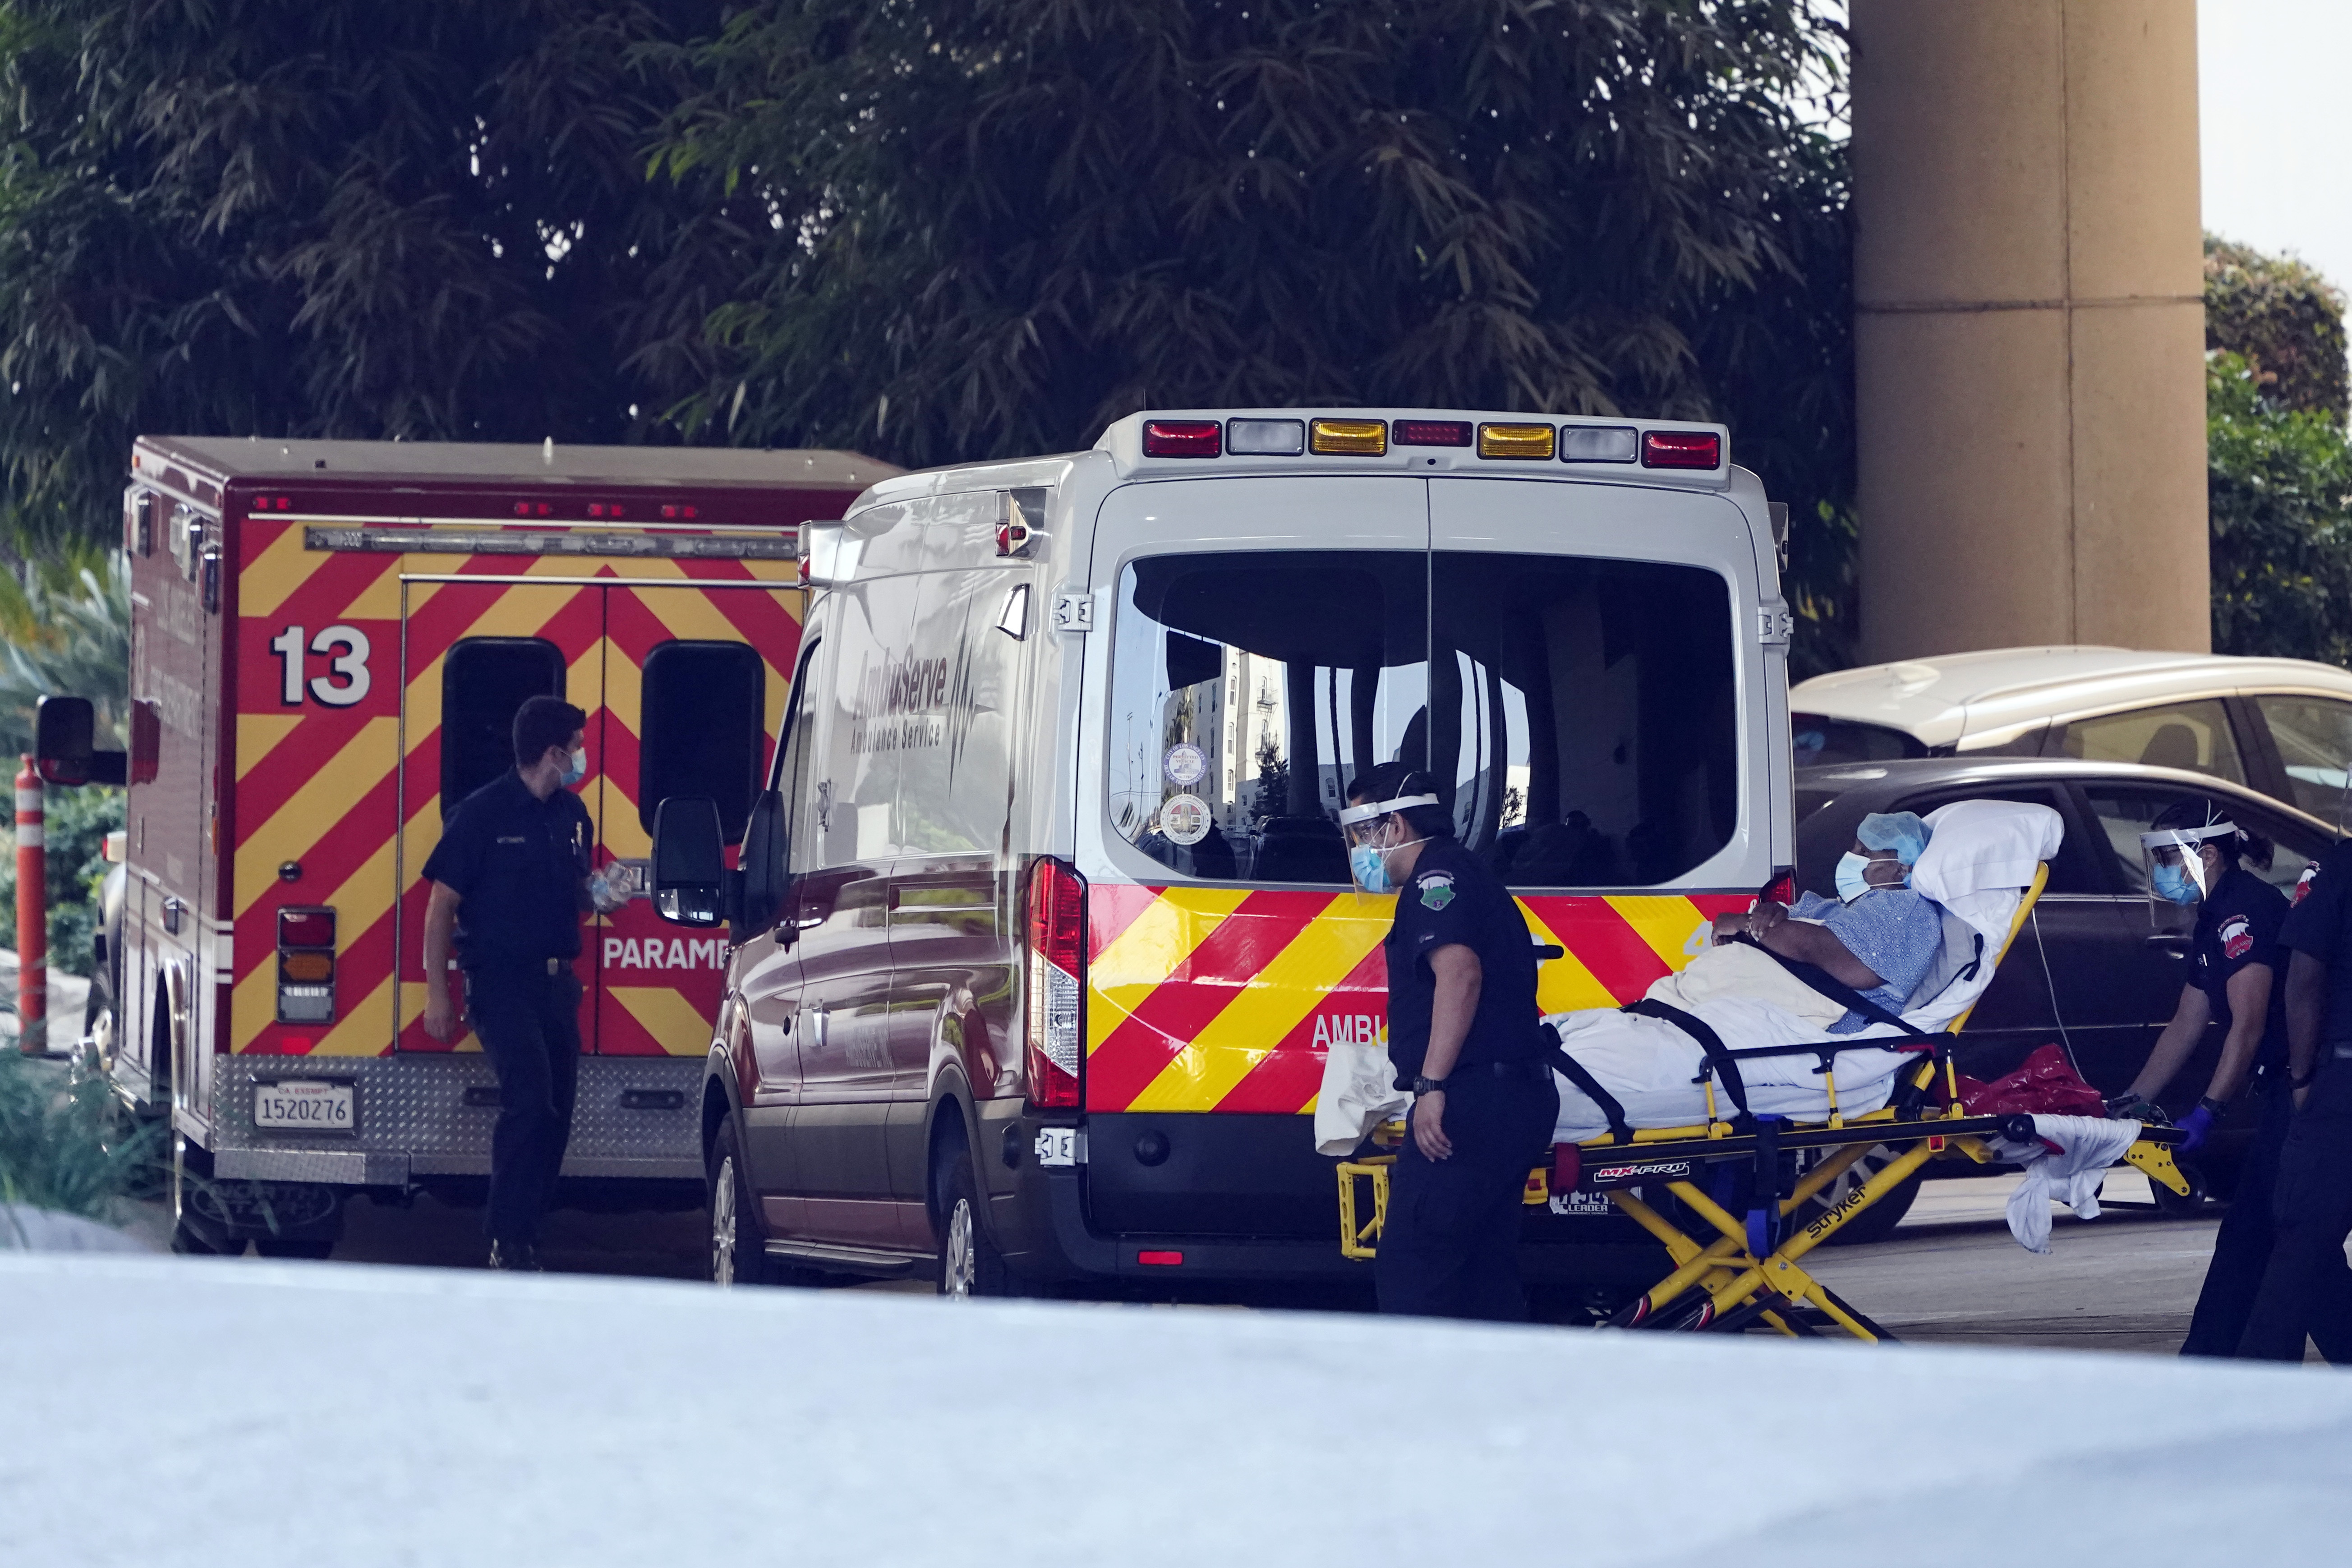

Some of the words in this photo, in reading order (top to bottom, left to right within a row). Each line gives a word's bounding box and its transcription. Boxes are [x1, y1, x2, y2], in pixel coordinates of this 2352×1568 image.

[270, 624, 370, 709] 13
[852, 642, 947, 721] AmbuServe
[850, 722, 898, 755] Ambulance
[902, 719, 940, 749] Service
[1165, 750, 1174, 759] CITY
[1190, 744, 1206, 760] ANGELES
[1164, 797, 1178, 809] COUNTY
[1192, 796, 1207, 810] ANGELES
[1312, 1014, 1389, 1048] AMBU
[262, 1099, 346, 1120] 1520276
[1598, 1163, 1686, 1177] MX-PRO
[1807, 1185, 1866, 1239] stryker
